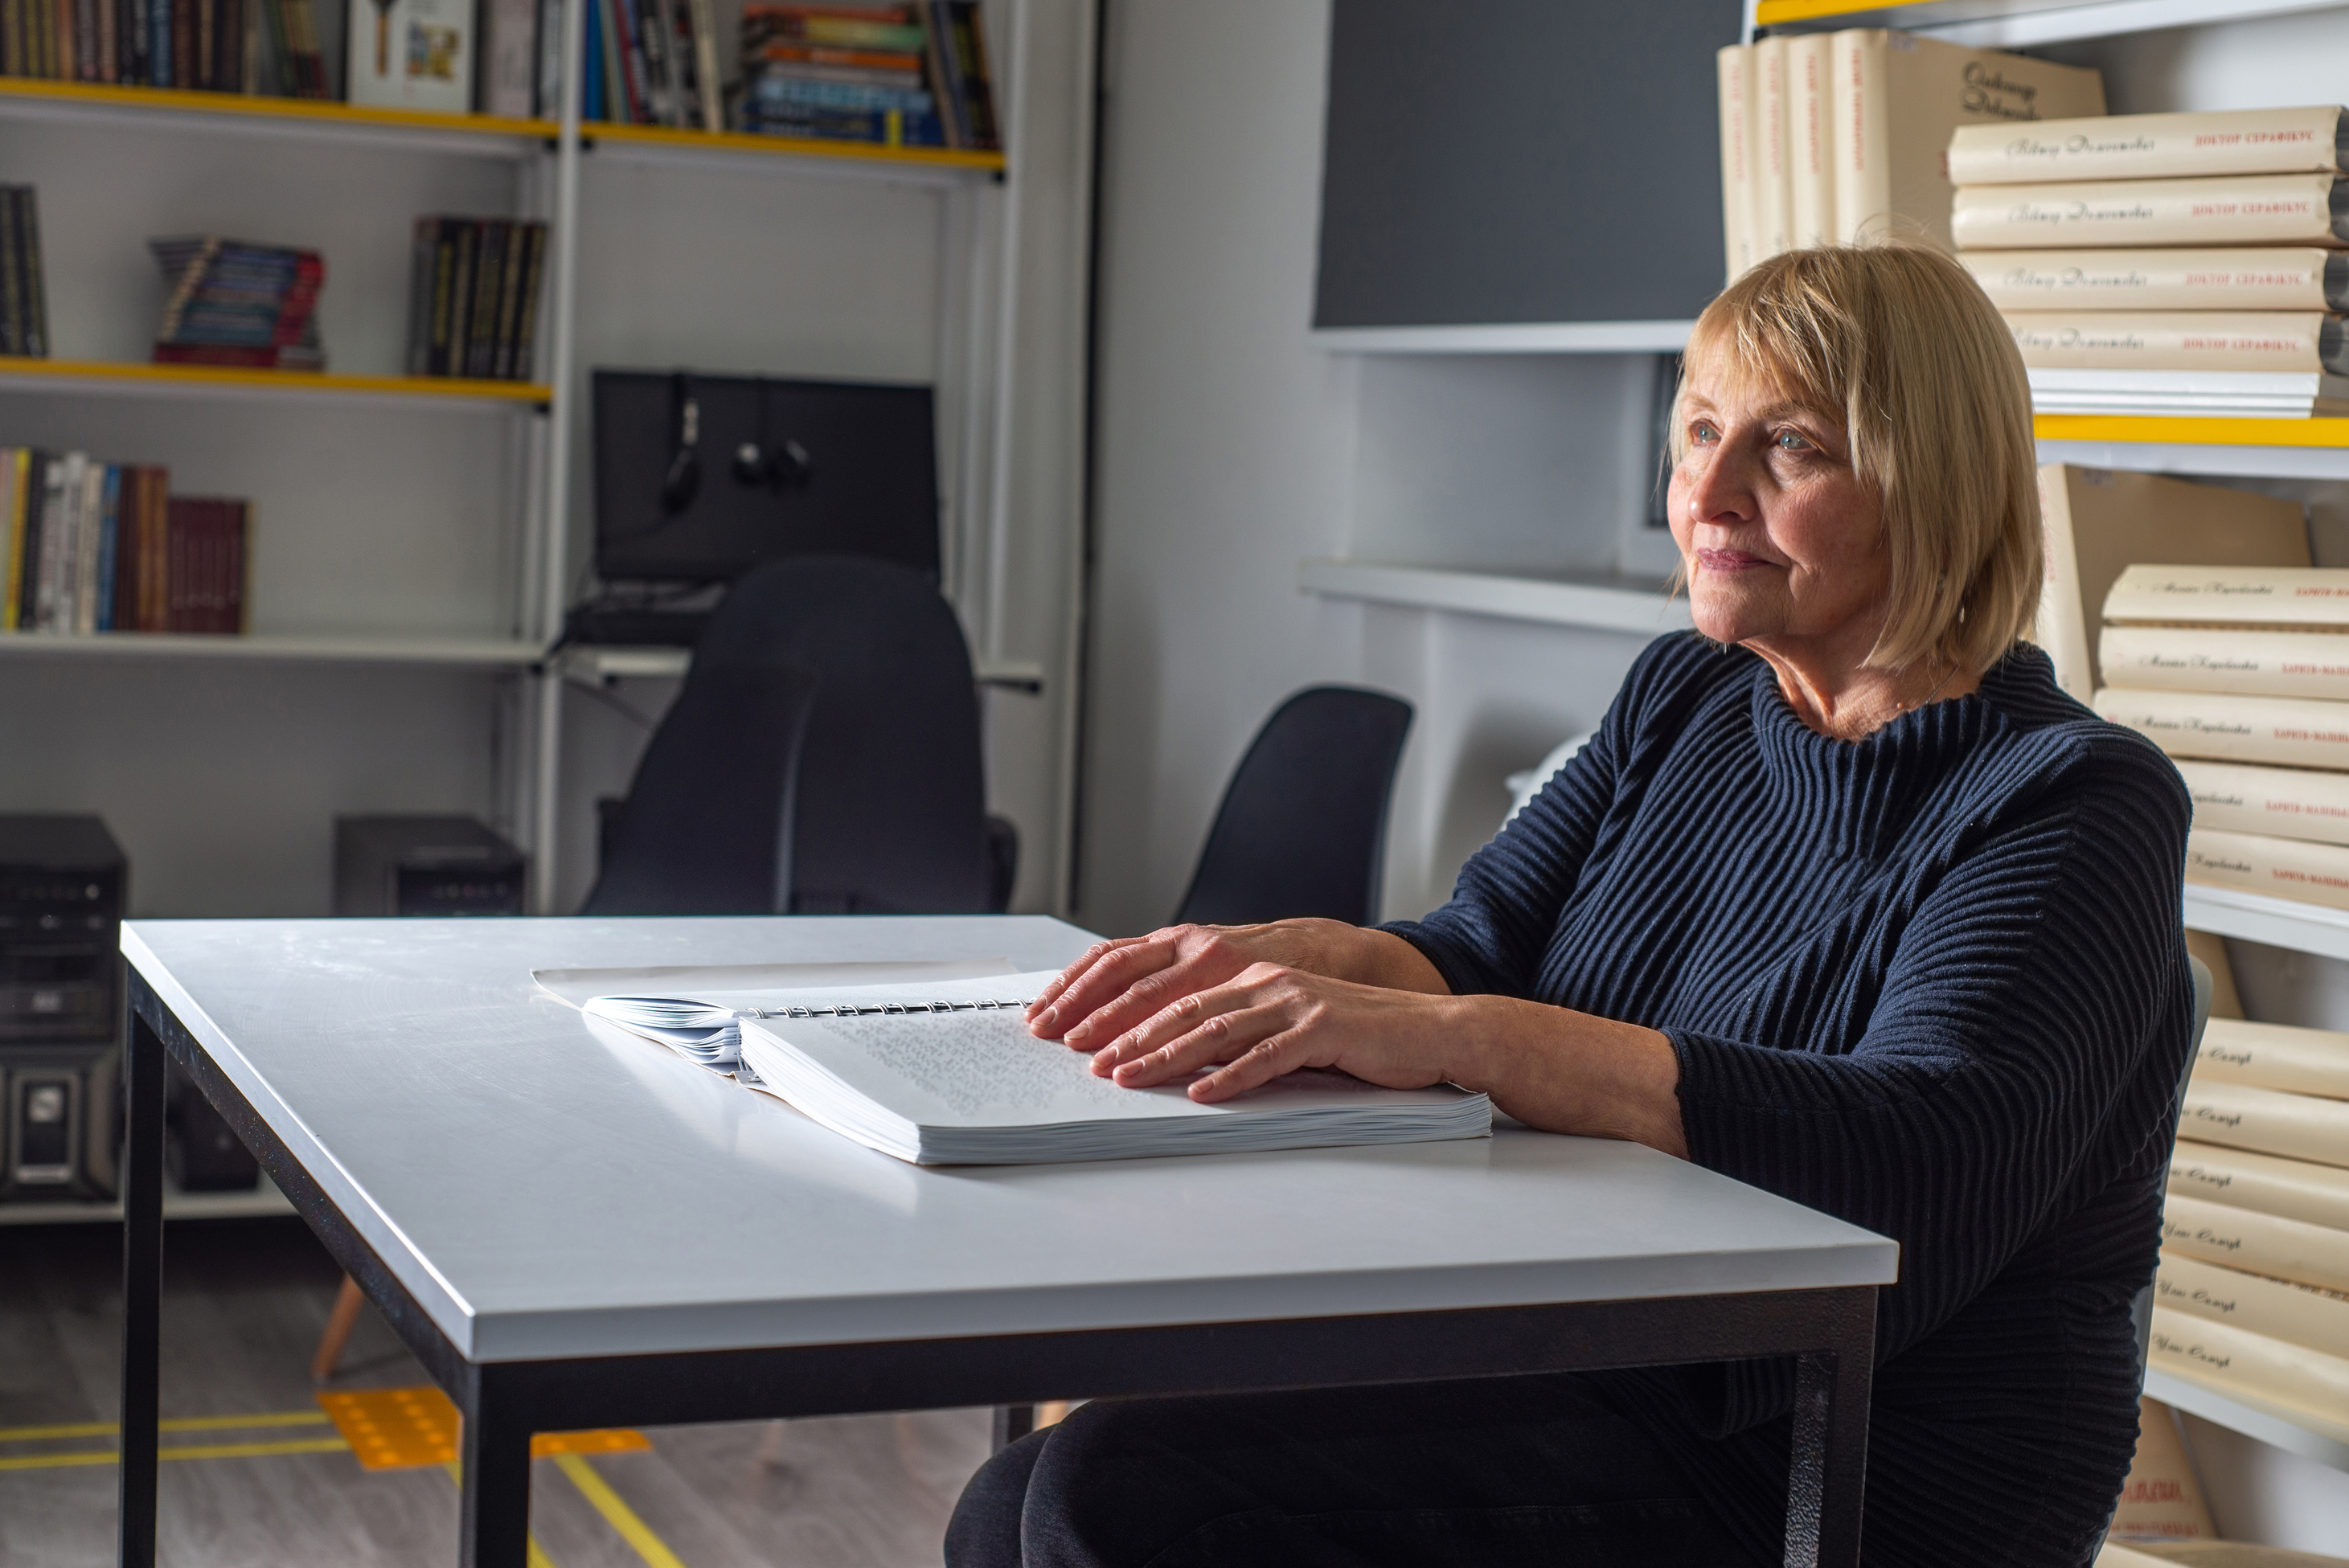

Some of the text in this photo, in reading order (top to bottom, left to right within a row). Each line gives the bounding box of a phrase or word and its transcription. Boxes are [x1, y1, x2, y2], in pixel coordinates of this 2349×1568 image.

[2195, 133, 2241, 147] ДОКТОР
[2245, 129, 2314, 145] СЕРАФІКУС
[2192, 203, 2238, 216] ДОКТОР
[2241, 201, 2310, 215] СЕРАФІКУС
[2186, 272, 2232, 286] ДОКТОР
[2234, 272, 2303, 286] СЕРАФІКУС
[2183, 336, 2228, 350] ДОКТОР
[2232, 338, 2299, 352] СЕРАФІКУС
